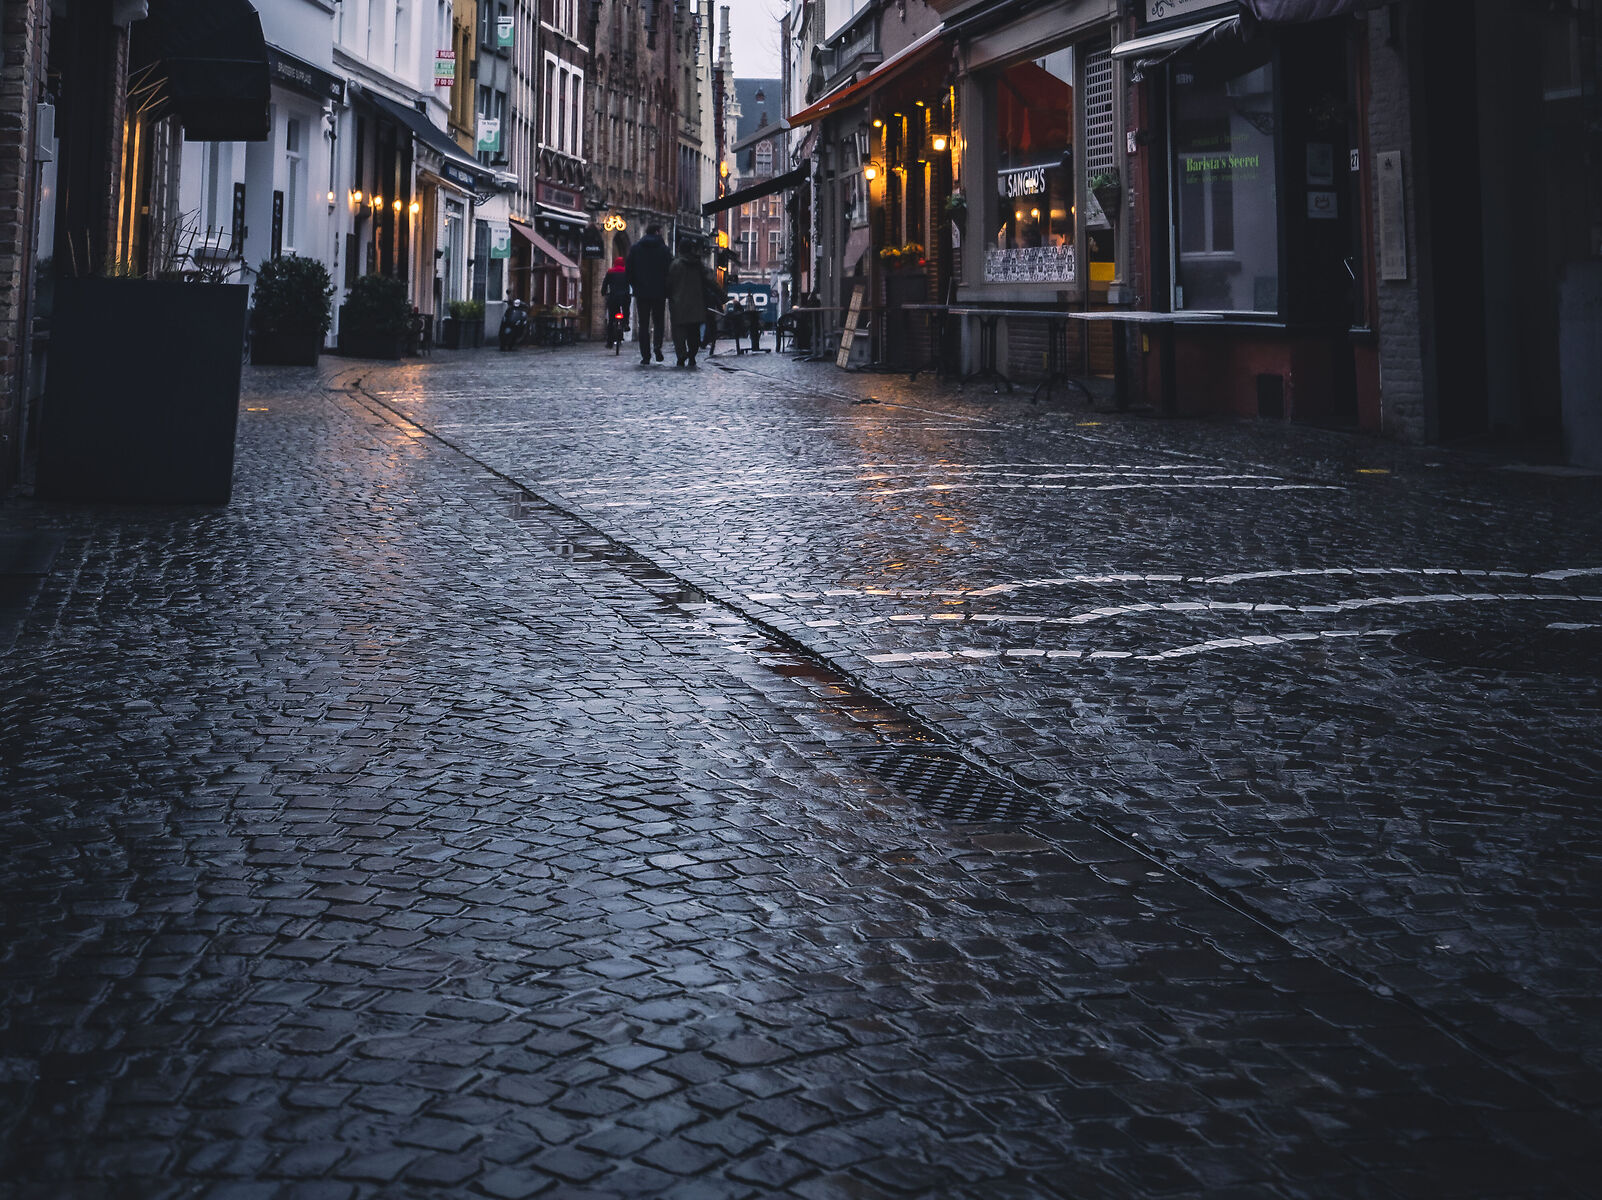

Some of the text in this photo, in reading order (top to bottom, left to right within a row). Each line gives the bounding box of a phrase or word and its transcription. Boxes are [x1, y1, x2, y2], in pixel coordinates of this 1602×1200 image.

[1186, 154, 1259, 172] Barista's Secret
[1351, 153, 1358, 167] 27
[1007, 165, 1046, 198] SANCHO'S
